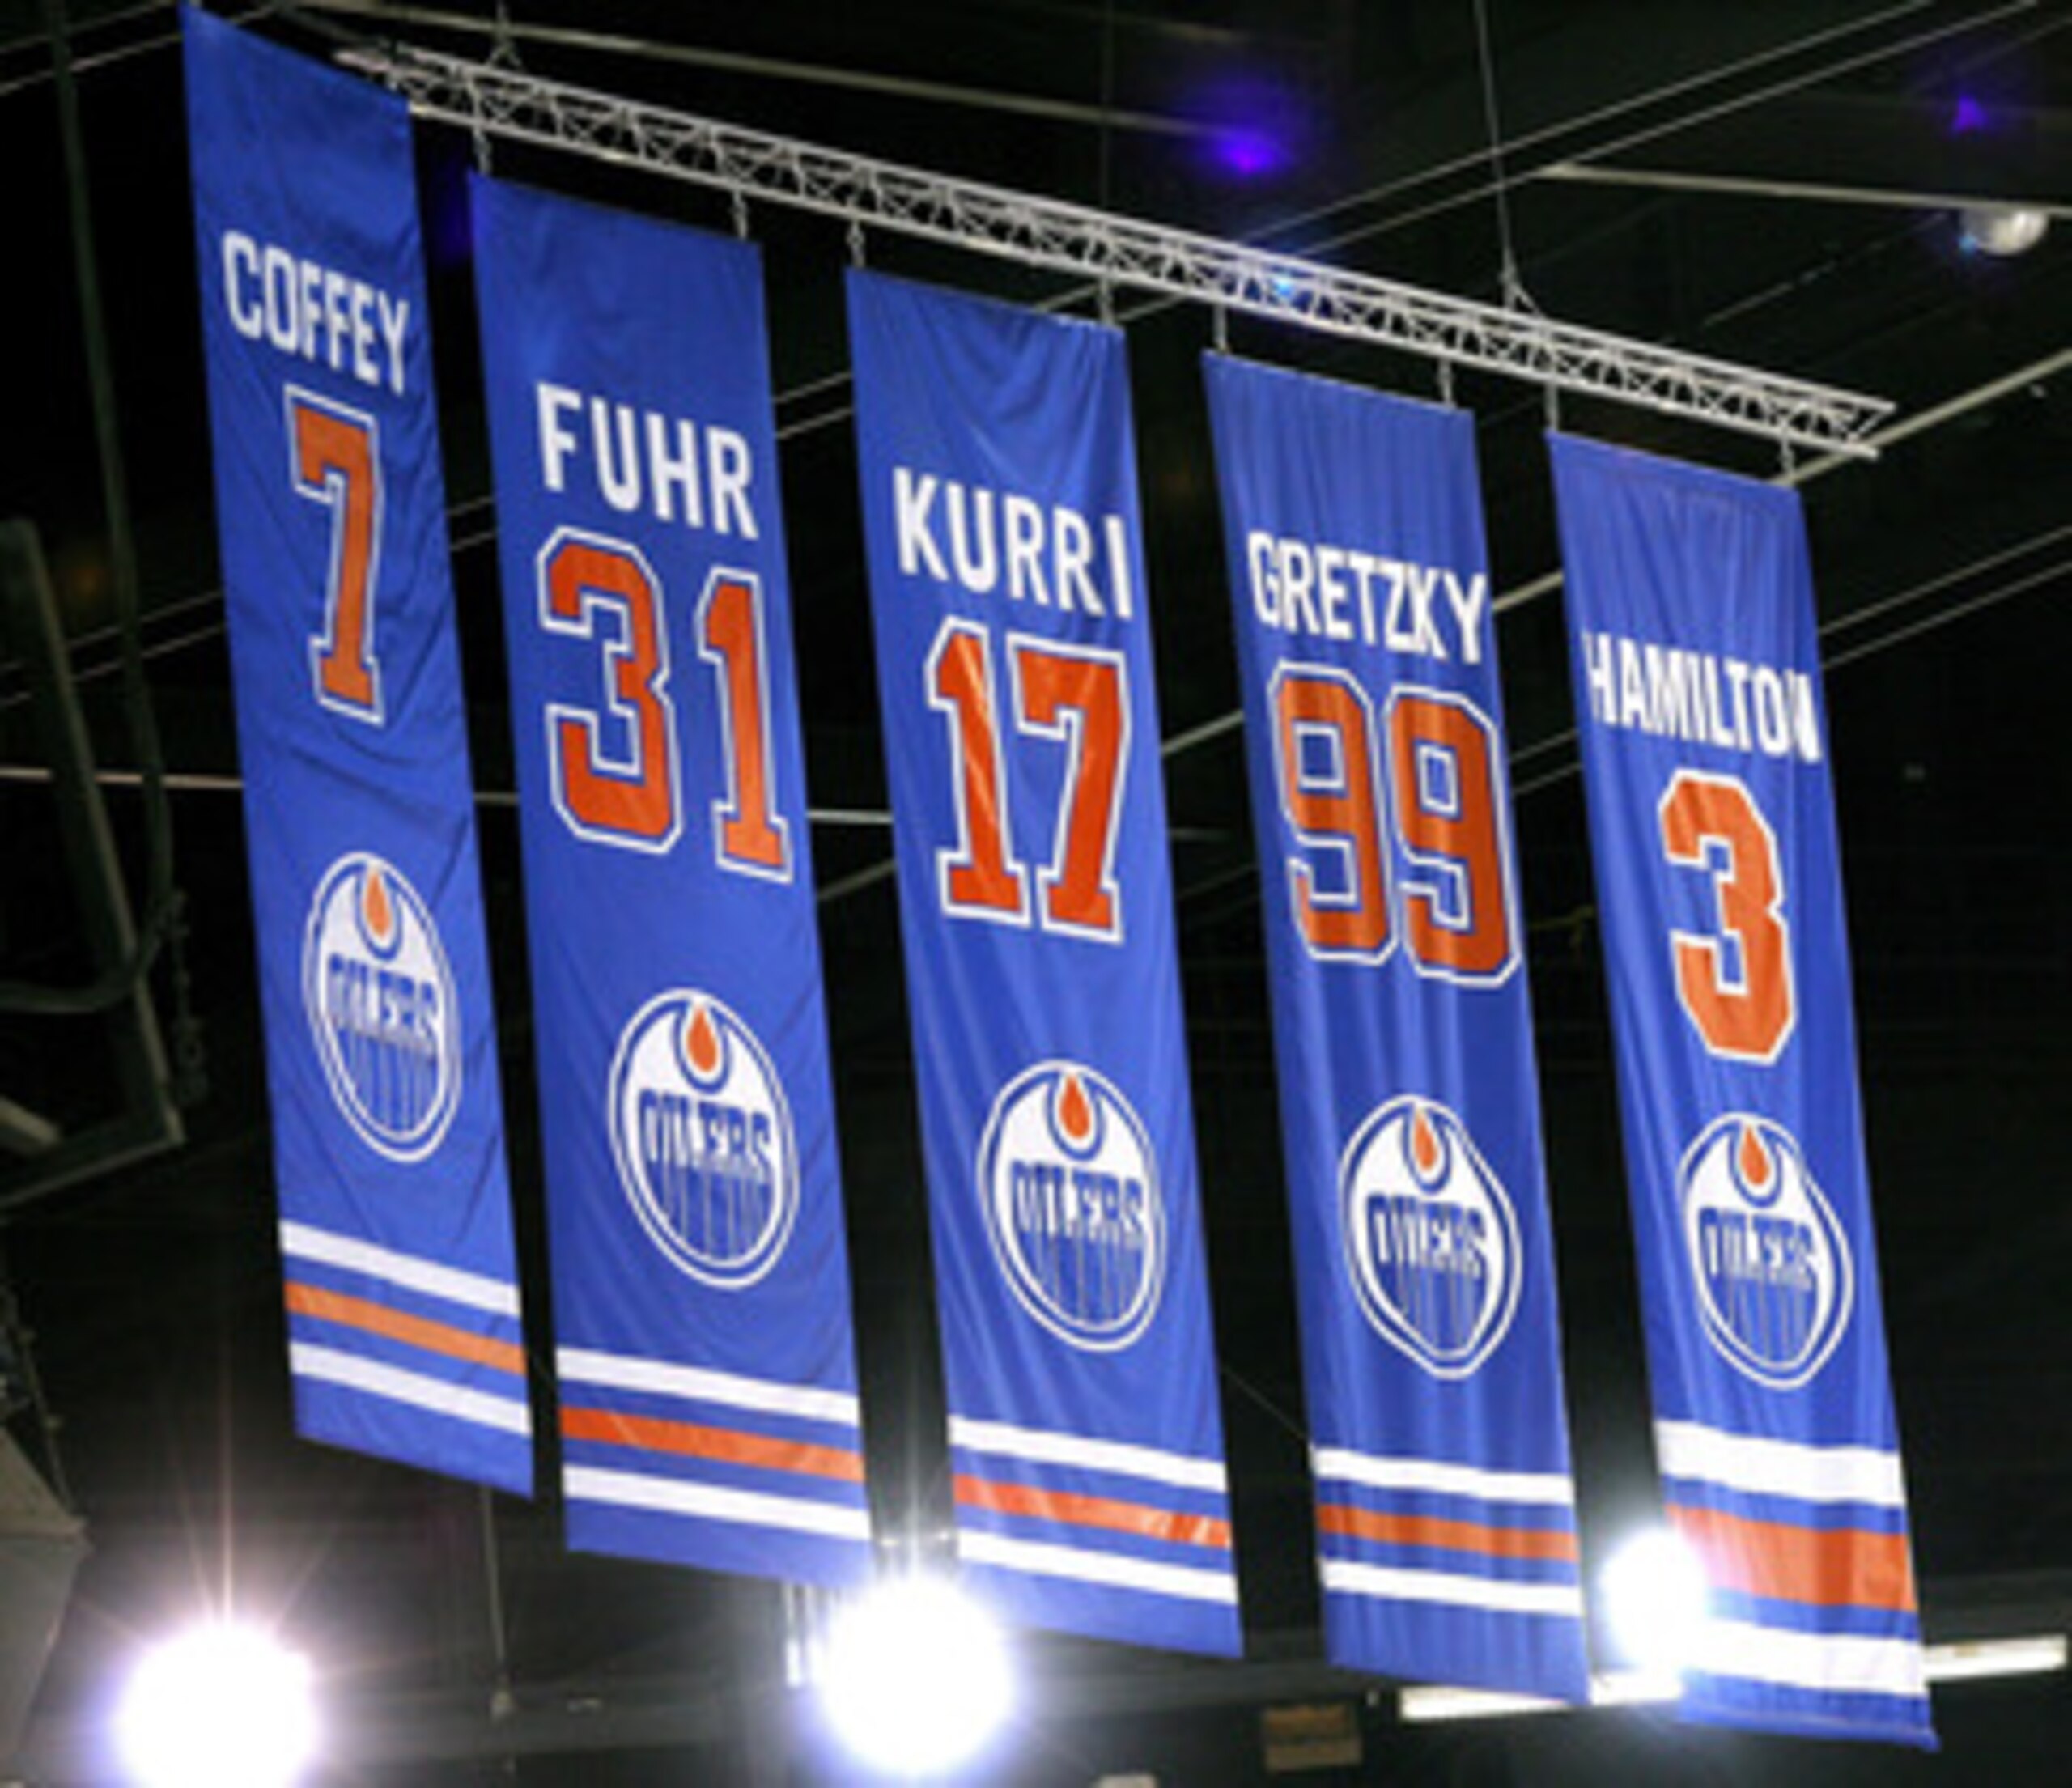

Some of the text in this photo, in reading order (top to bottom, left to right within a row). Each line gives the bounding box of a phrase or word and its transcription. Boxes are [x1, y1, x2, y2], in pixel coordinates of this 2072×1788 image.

[223, 230, 409, 396] COFFEY
[284, 384, 383, 725] 7
[537, 382, 759, 540] FUHR
[893, 466, 1132, 619] KURRI
[537, 526, 792, 884] 31
[1246, 531, 1487, 664] GRETZKY
[1582, 630, 1821, 762] HAMILTON
[925, 615, 1128, 943] 17
[1267, 659, 1522, 988] 99
[1657, 768, 1797, 1065] 3
